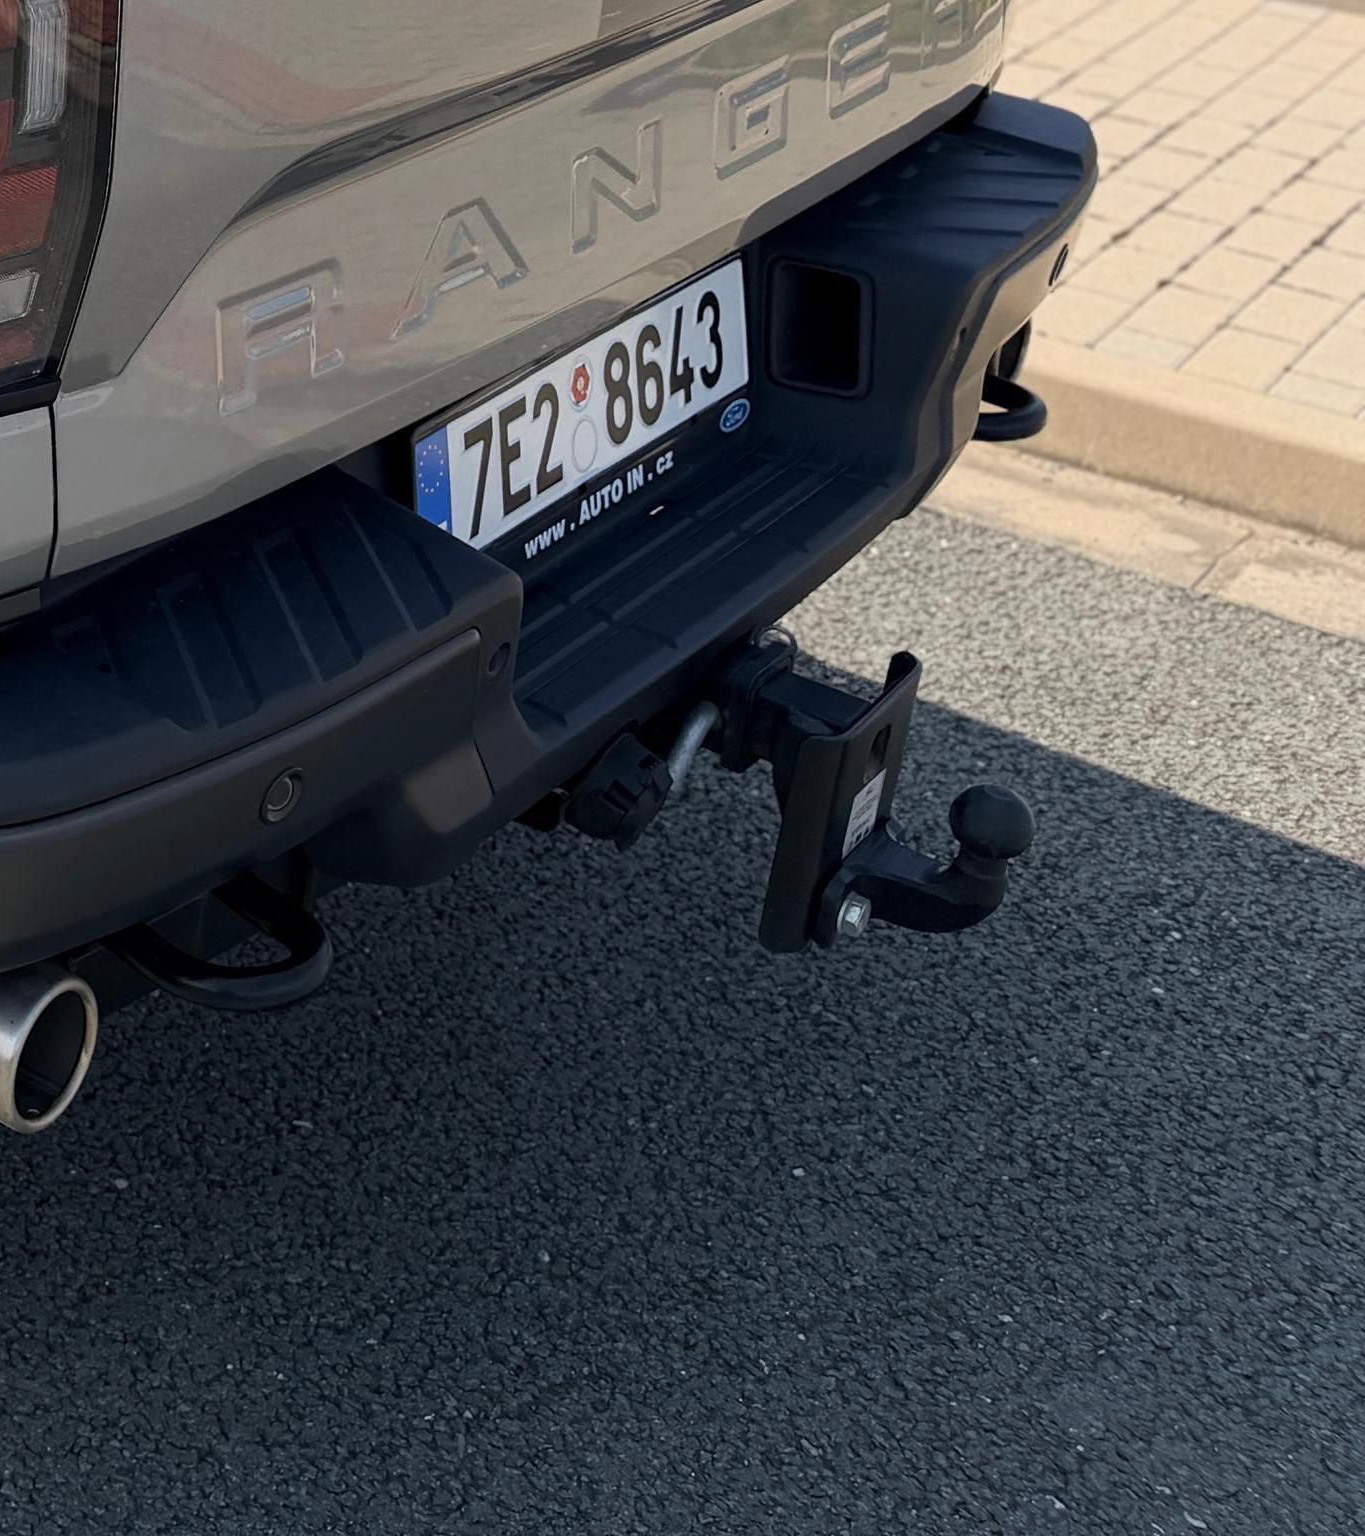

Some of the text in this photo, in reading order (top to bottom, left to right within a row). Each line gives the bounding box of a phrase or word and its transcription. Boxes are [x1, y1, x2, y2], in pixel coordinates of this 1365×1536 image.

[463, 290, 723, 538] 7E2 8643
[579, 478, 623, 525] AUTO
[627, 464, 644, 494] IN
